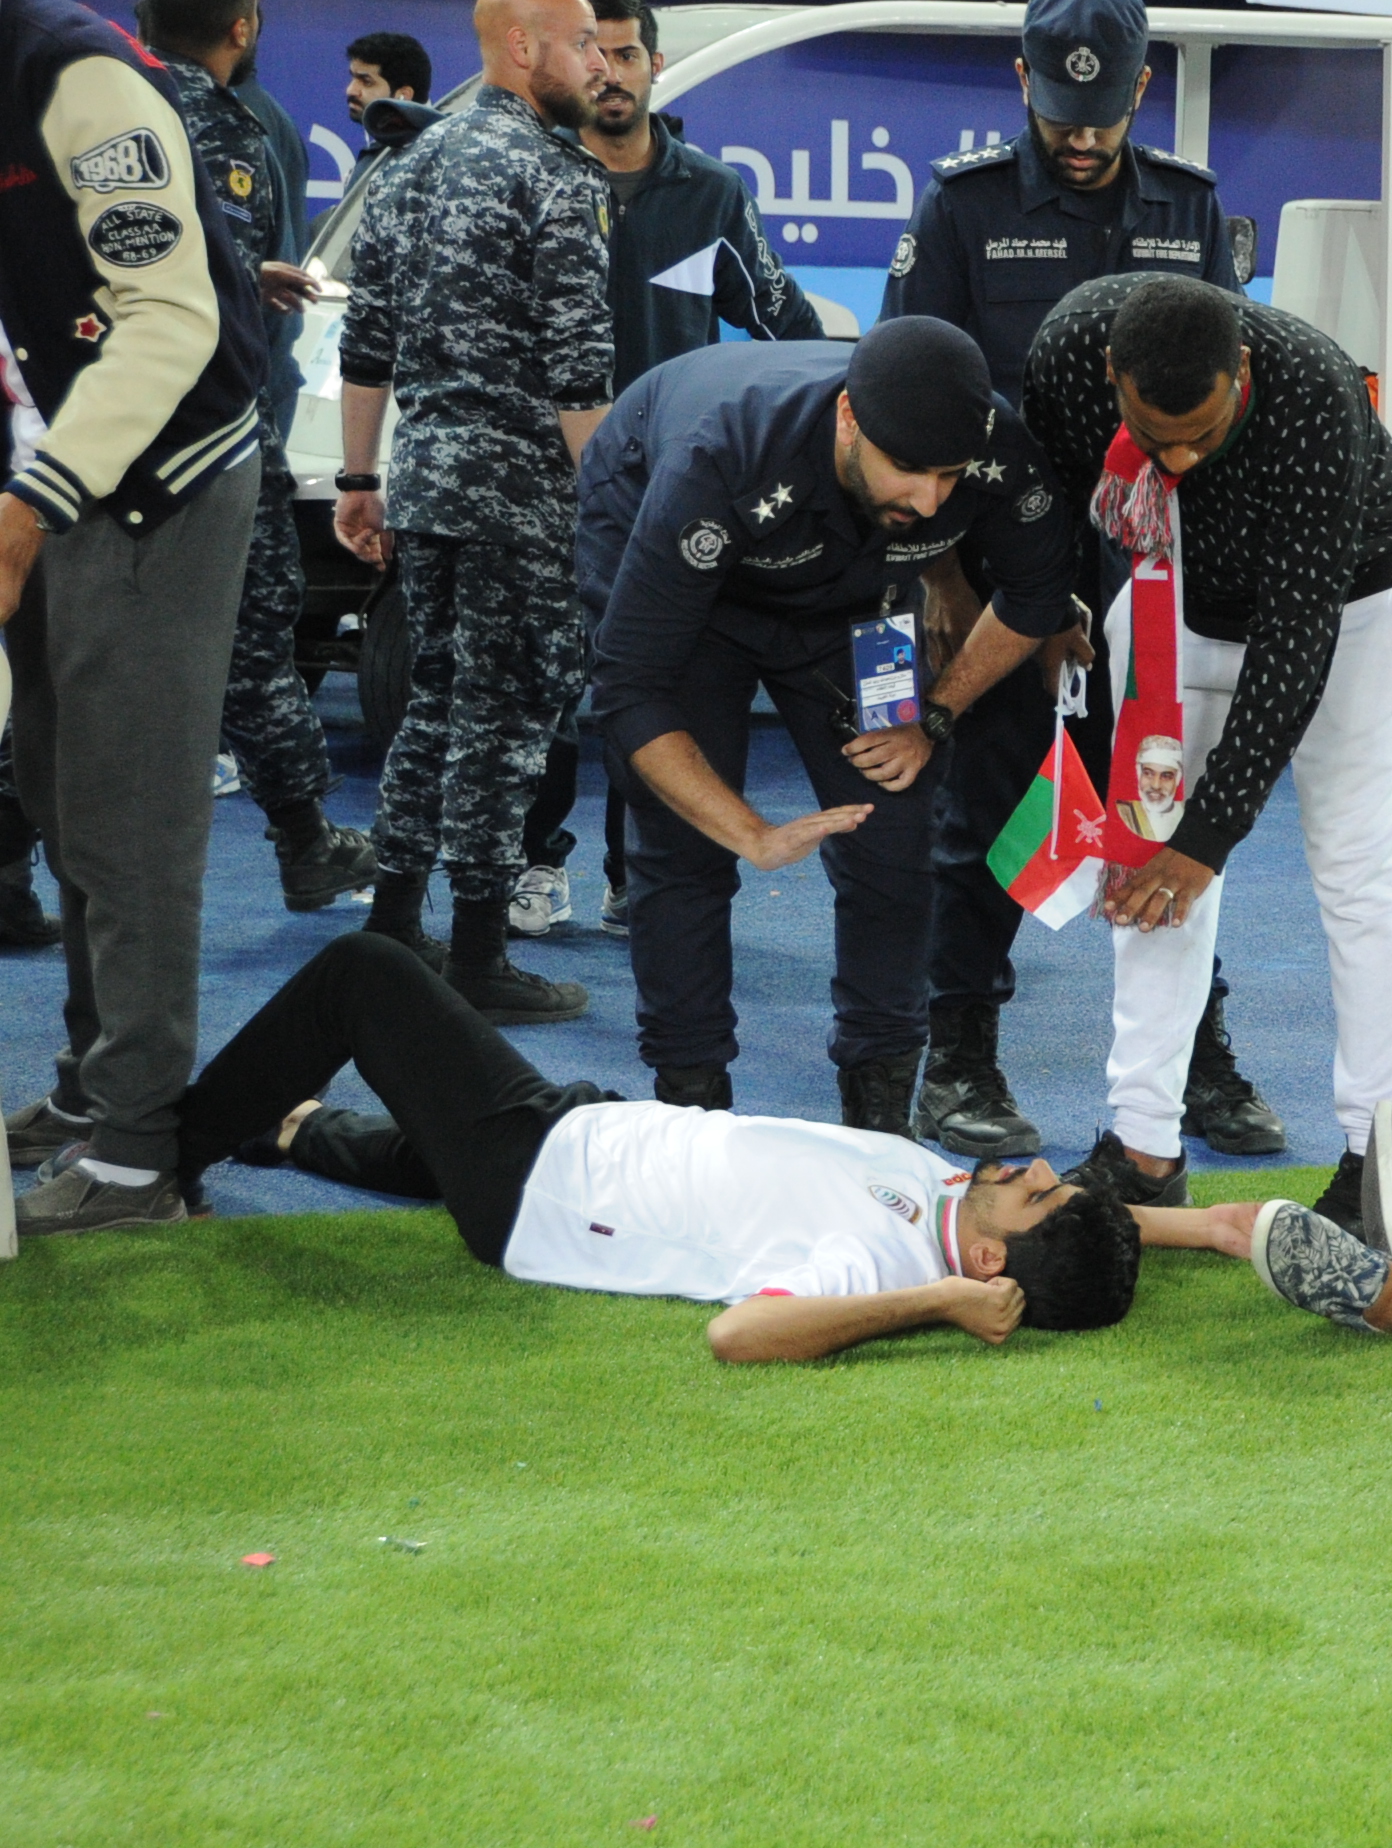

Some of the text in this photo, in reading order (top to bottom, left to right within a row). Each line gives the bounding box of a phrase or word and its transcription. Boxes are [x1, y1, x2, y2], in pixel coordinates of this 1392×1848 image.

[80, 139, 143, 182] 1968
[101, 208, 163, 233] ALL STATE
[108, 225, 141, 241] CLASS
